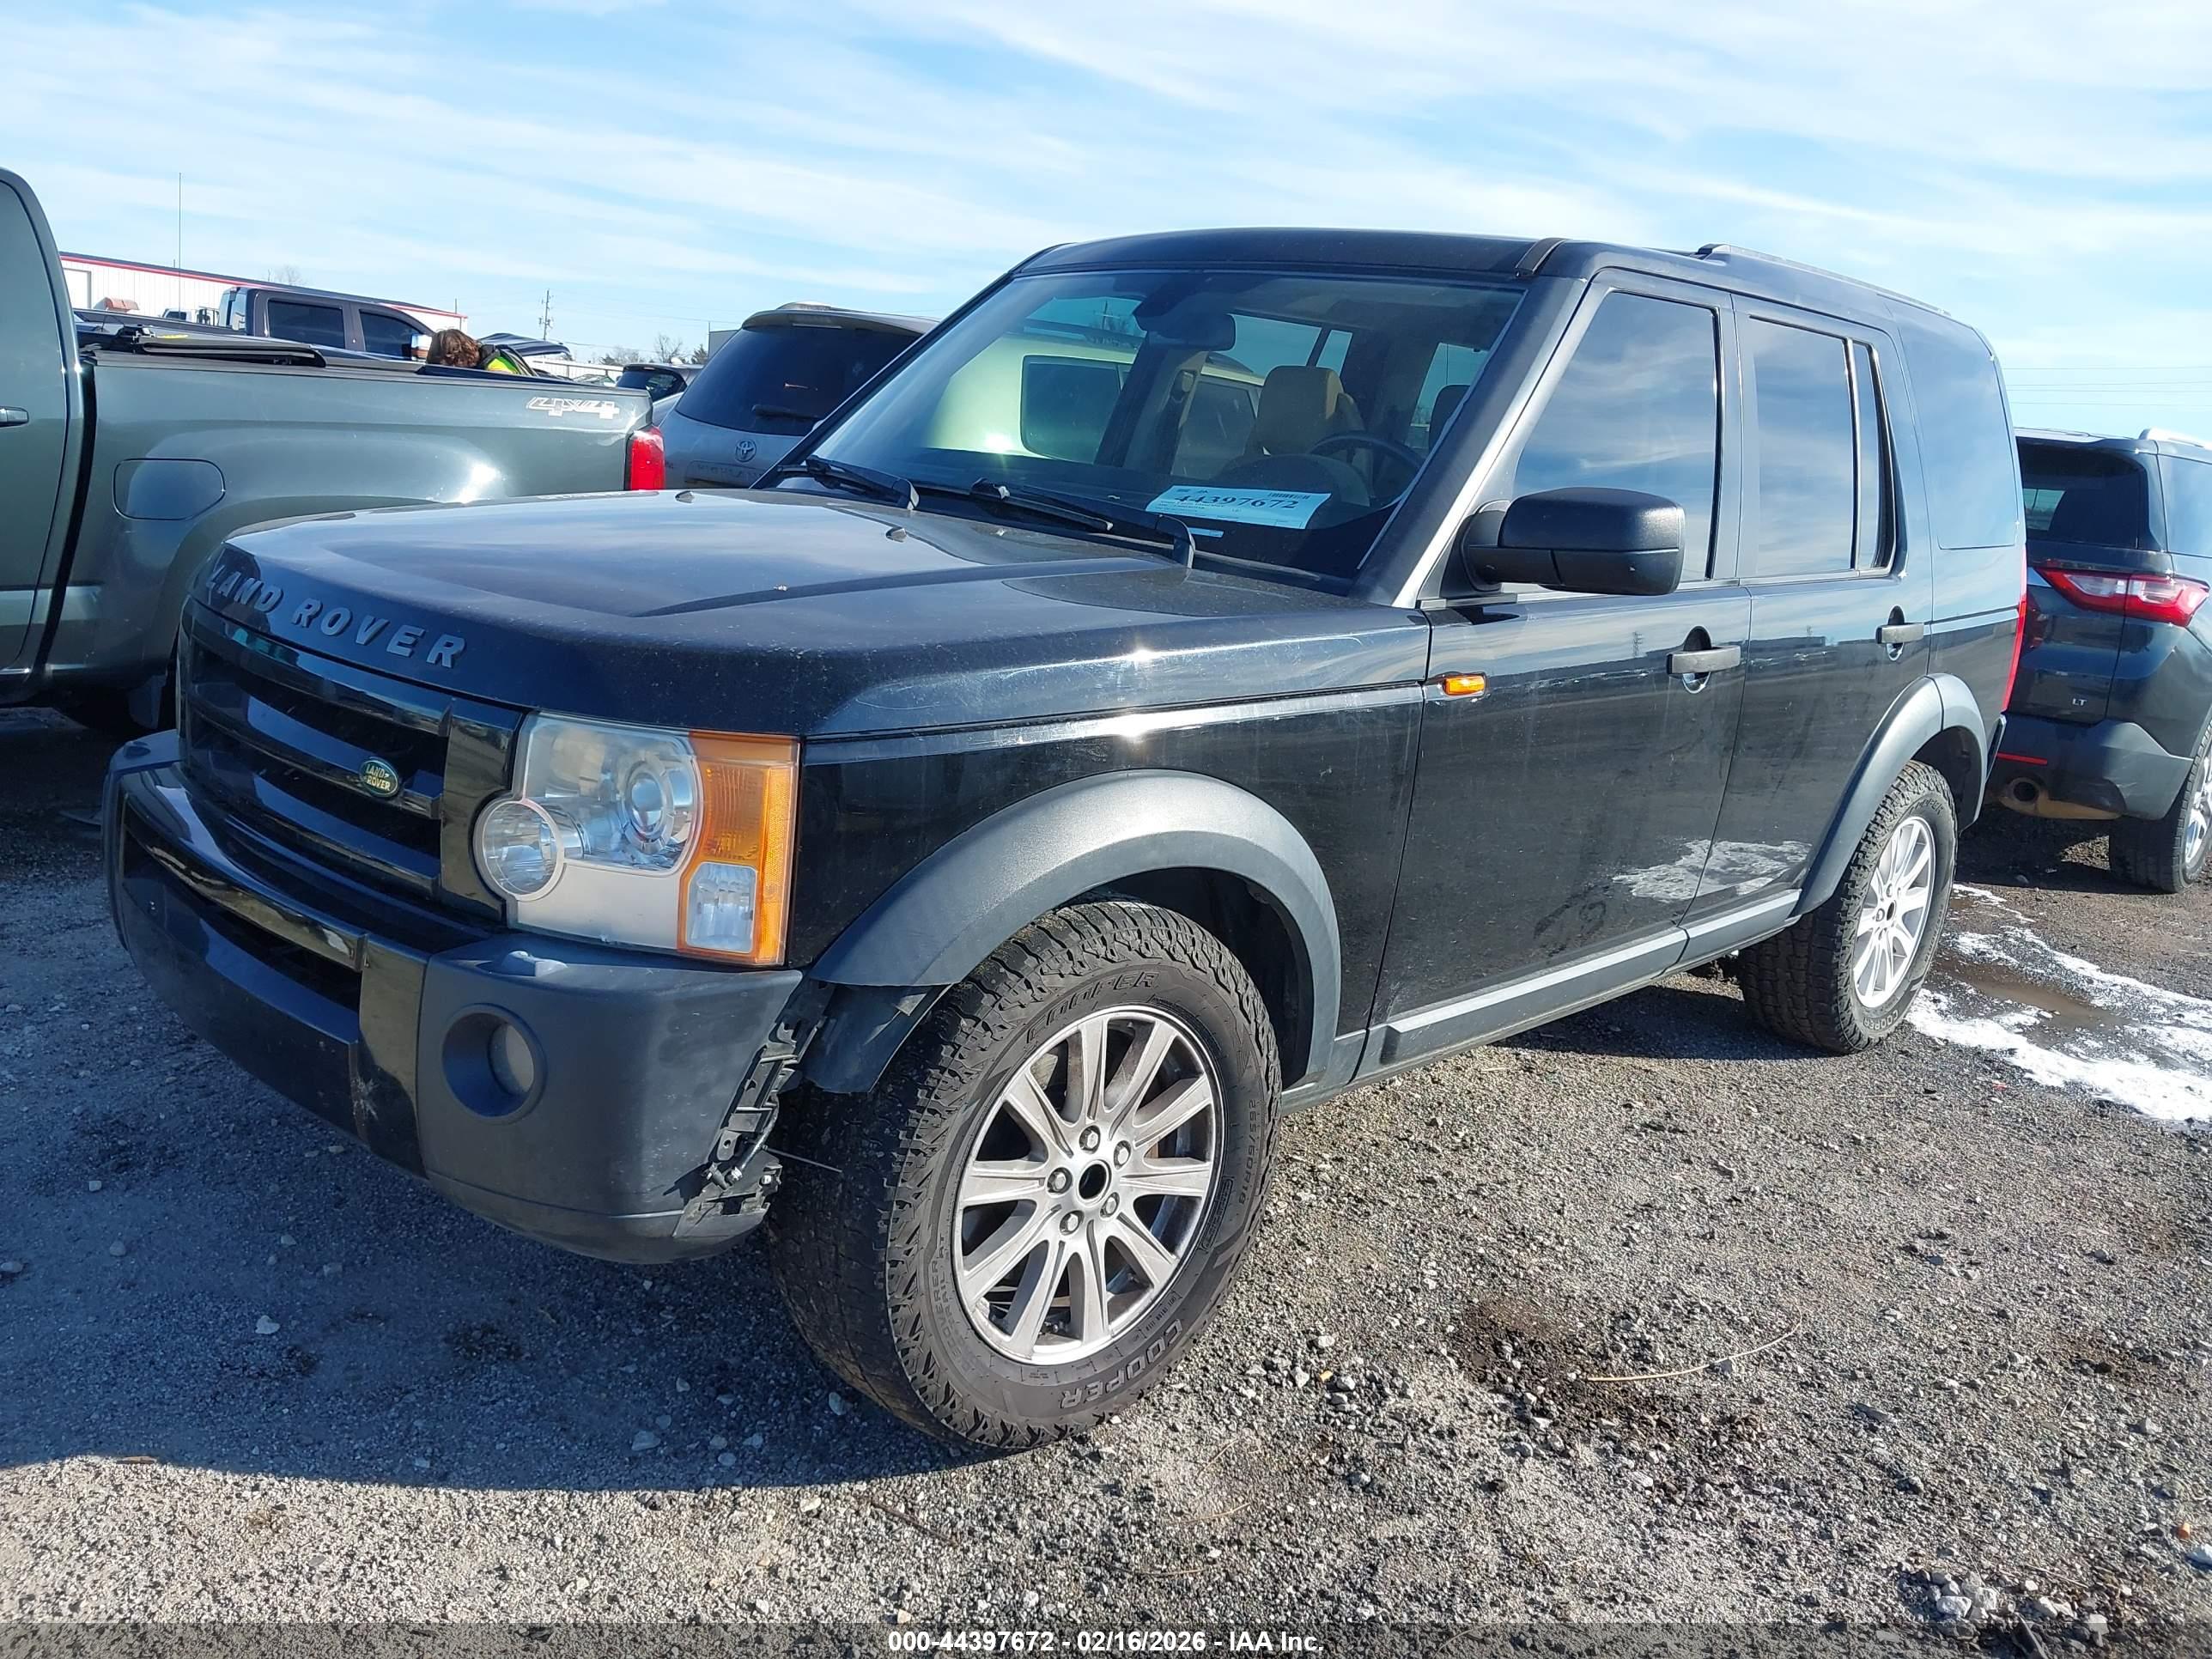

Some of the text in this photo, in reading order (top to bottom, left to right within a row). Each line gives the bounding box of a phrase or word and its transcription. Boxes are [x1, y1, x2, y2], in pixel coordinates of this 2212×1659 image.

[1174, 495, 1300, 509] 44397672
[205, 564, 466, 669] LAND ROVER
[2072, 698, 2087, 707] LT
[367, 775, 391, 792] ROVER
[1863, 1009, 1899, 1030] COOPER
[1060, 1318, 1183, 1409] COOPER
